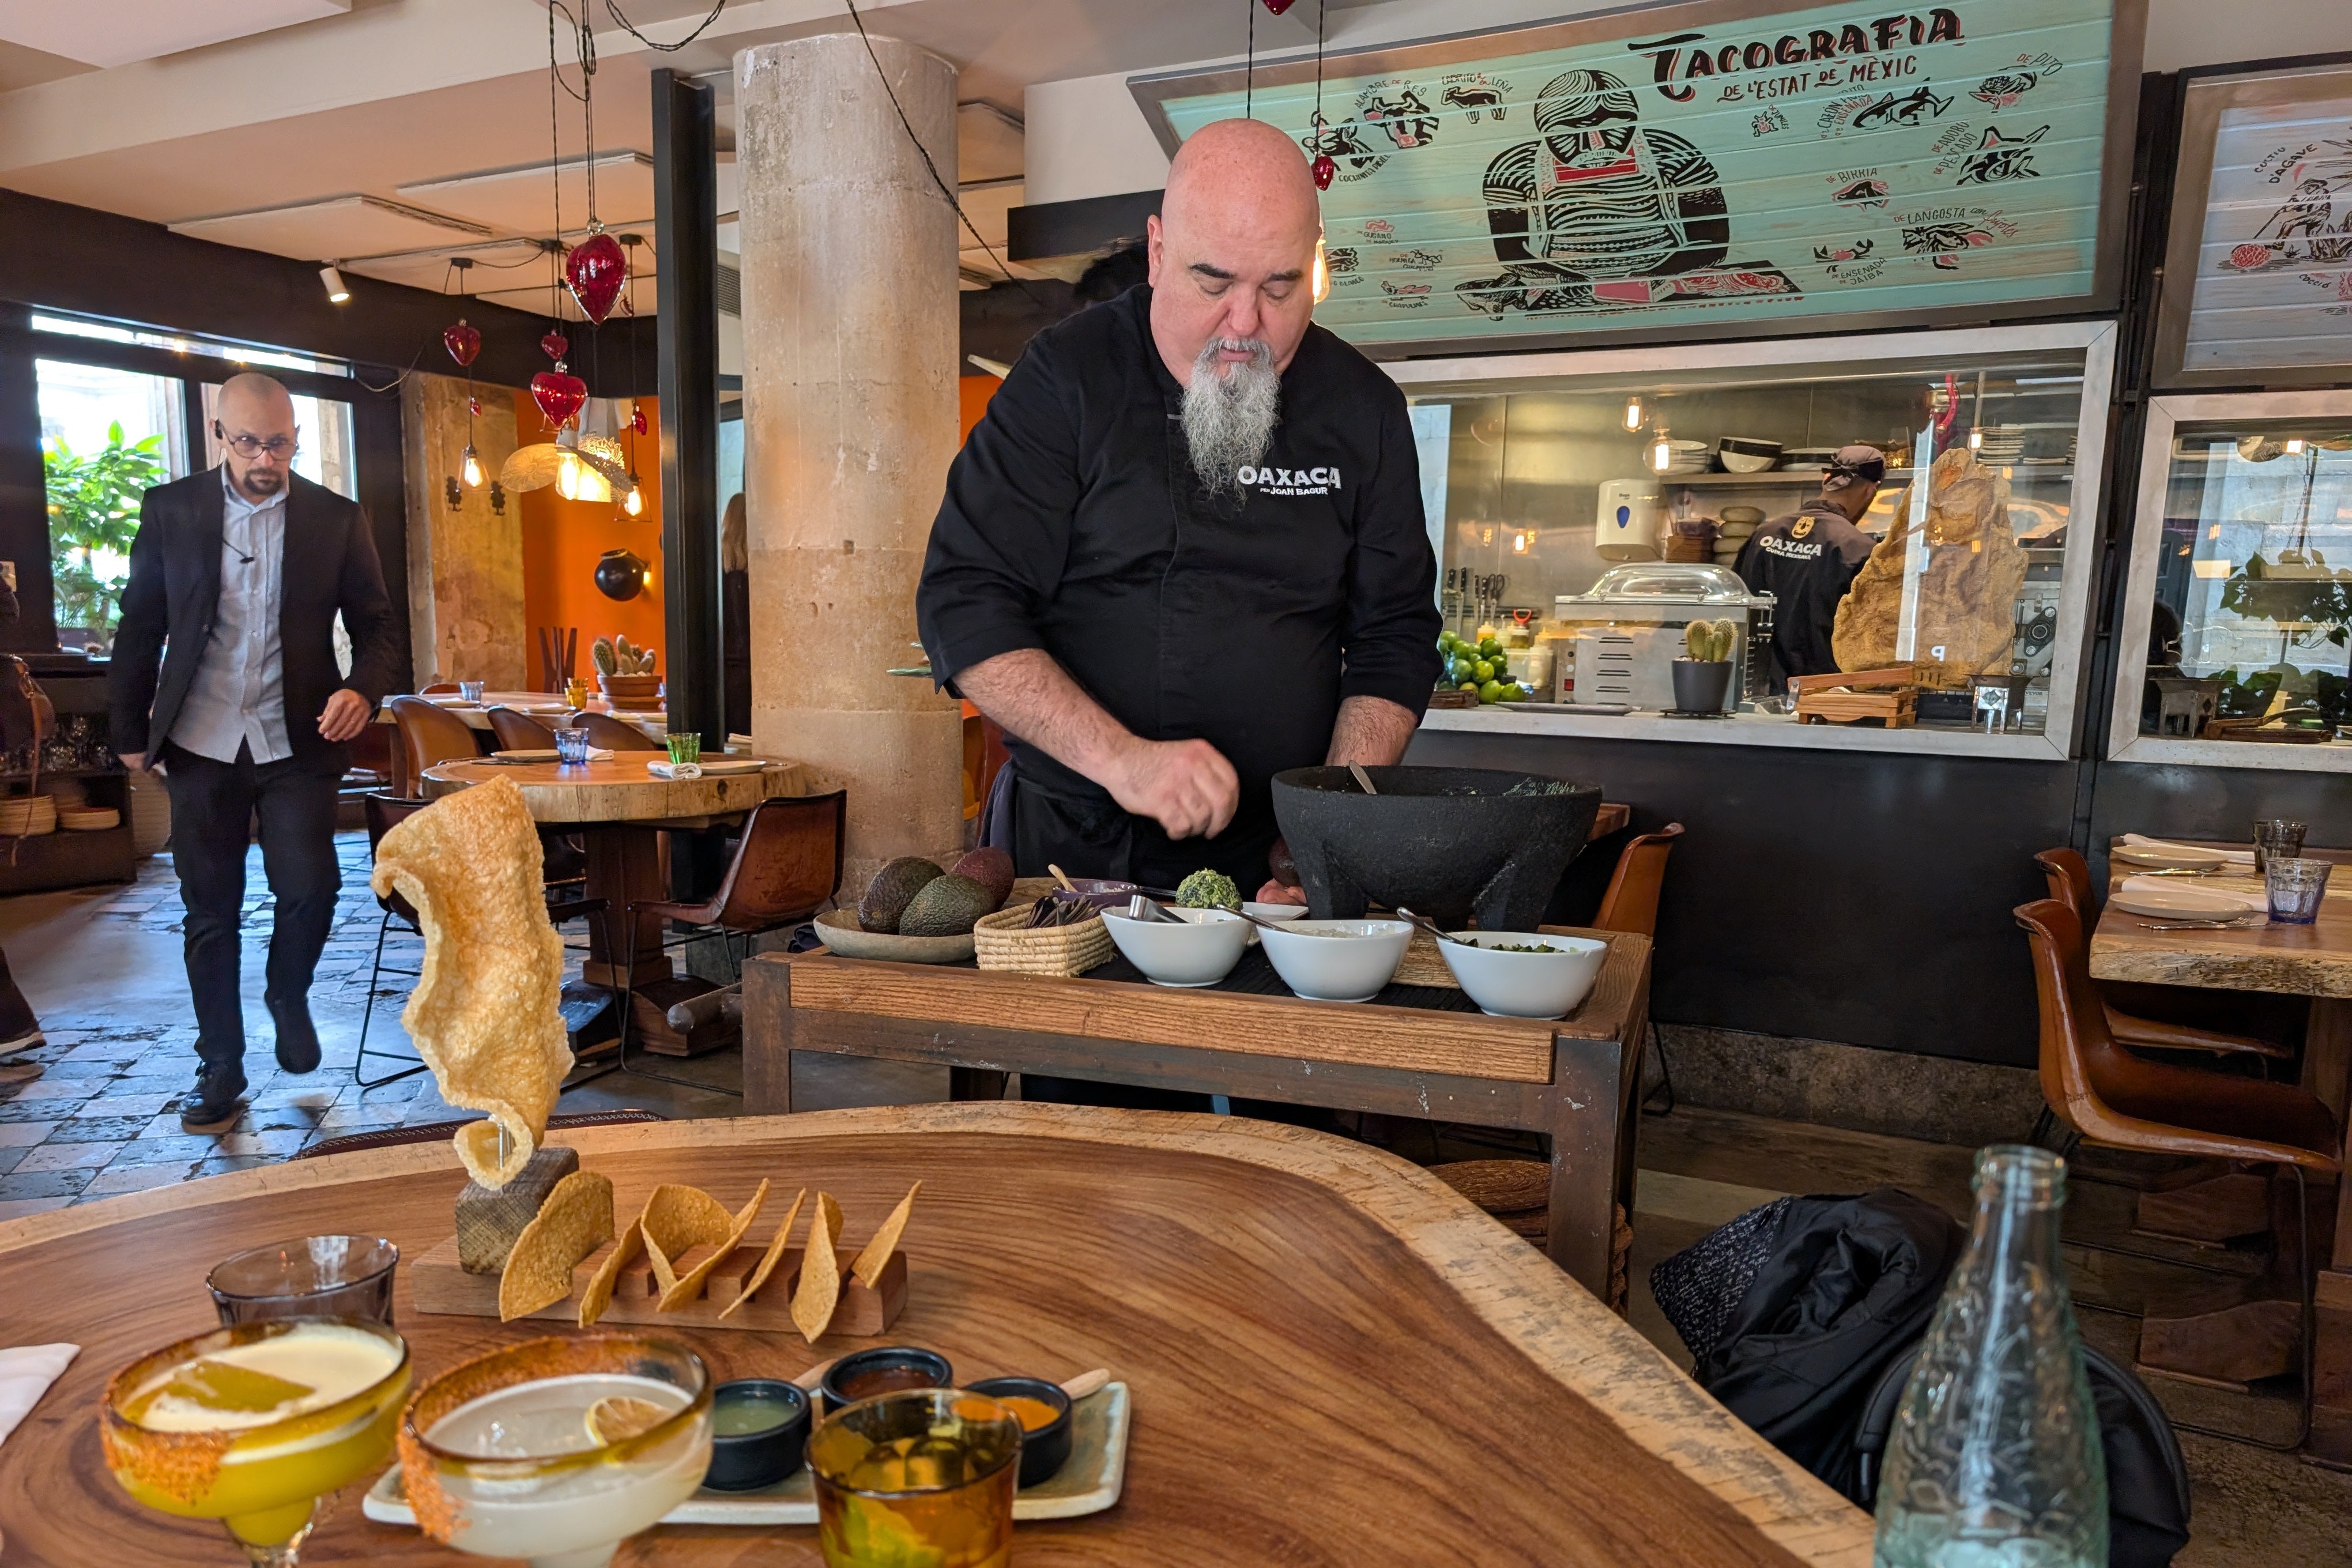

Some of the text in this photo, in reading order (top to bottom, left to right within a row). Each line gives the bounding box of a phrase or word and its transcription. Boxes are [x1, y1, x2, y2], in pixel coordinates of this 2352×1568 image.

[1627, 8, 1965, 102] TACOGRAFIA
[2016, 52, 2063, 76] DE PITO
[1355, 81, 1389, 109] ALAMBRE
[1403, 80, 1427, 96] RES
[1491, 77, 1513, 93] LEÑA
[1747, 73, 1811, 100] L'ESTAT
[1834, 94, 1874, 125] ENSENADA
[1931, 144, 1944, 153] DE
[1938, 133, 1977, 169] PESCADO
[2268, 144, 2318, 183] D'AGAVE
[1826, 175, 1836, 183] DE
[1908, 208, 1965, 224] LANGOSTA
[1841, 257, 1887, 279] ENSENADA
[1850, 270, 1883, 285] JAIBA
[1238, 466, 1341, 489] OAXACA
[1271, 487, 1295, 496] JOAN
[1295, 487, 1329, 496] BAGUR
[1759, 536, 1822, 556] OAXACA
